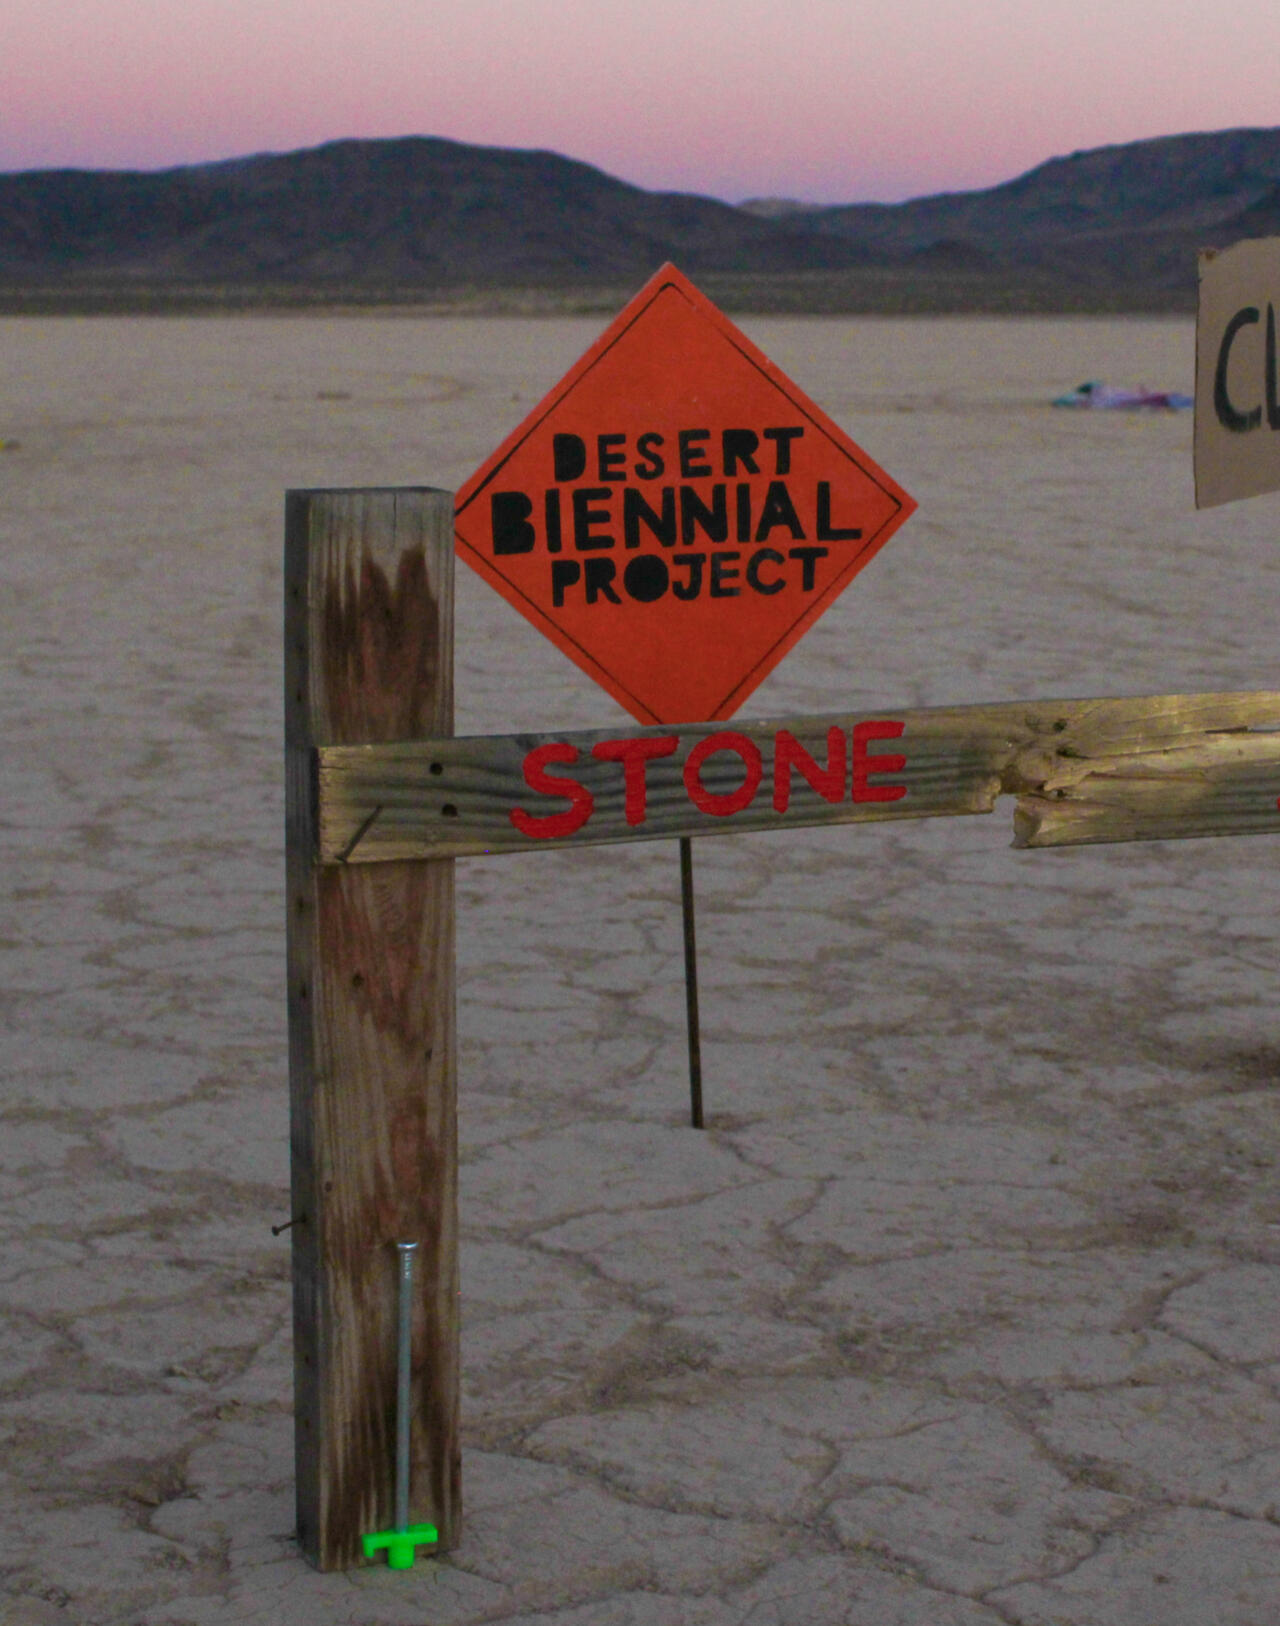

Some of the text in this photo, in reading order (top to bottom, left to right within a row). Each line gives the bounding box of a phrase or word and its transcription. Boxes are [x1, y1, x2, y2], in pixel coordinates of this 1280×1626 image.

[553, 427, 803, 482] DESERT
[491, 481, 862, 555] BIENNIAL
[552, 547, 828, 607] PROJECT
[509, 720, 906, 839] STONE
